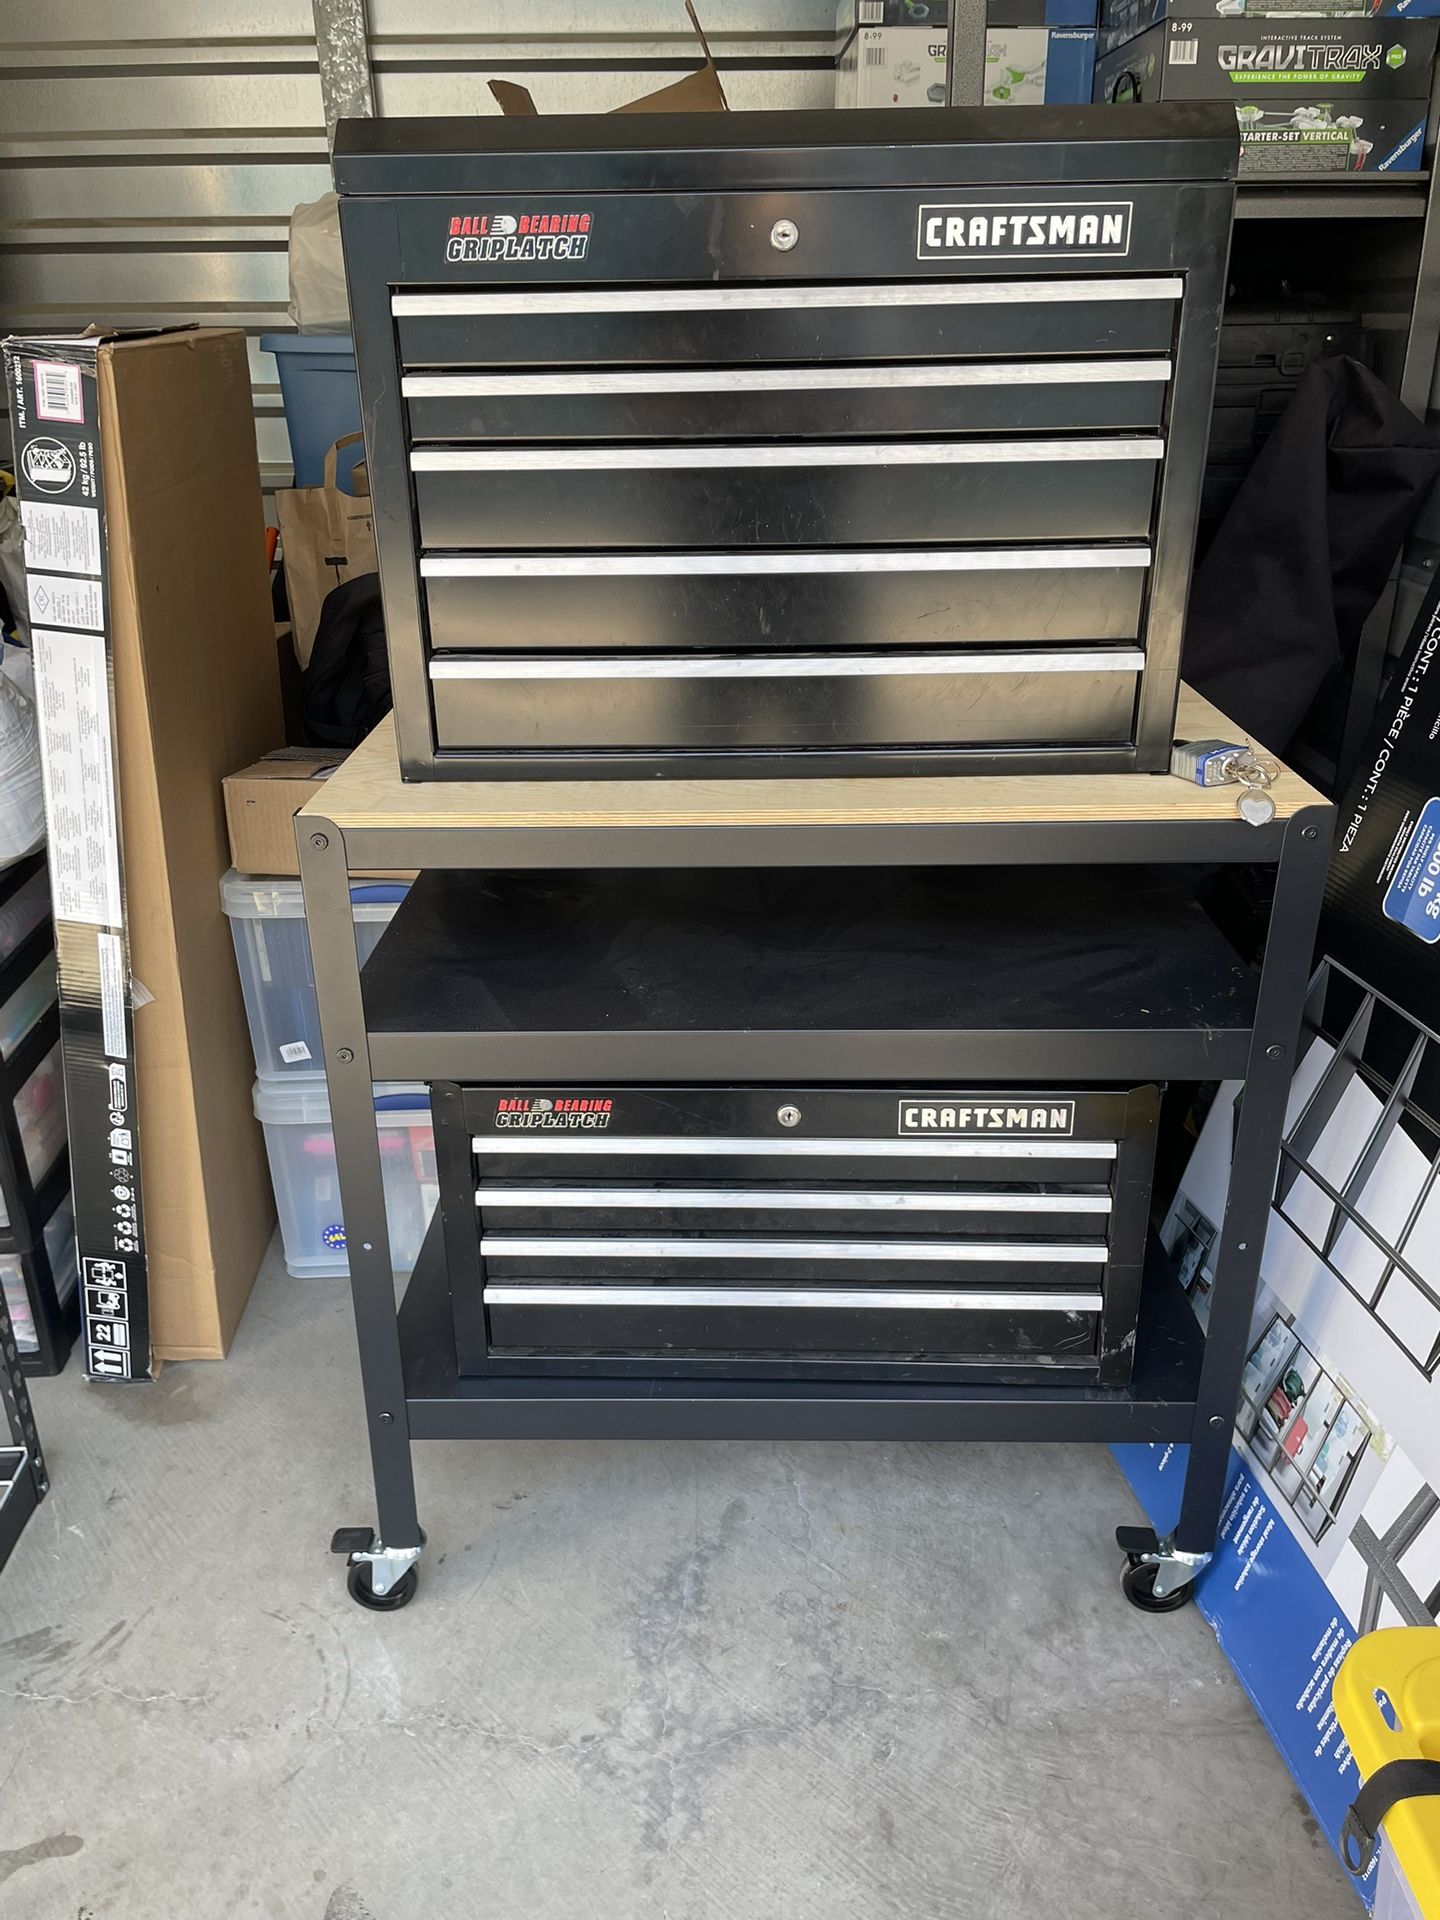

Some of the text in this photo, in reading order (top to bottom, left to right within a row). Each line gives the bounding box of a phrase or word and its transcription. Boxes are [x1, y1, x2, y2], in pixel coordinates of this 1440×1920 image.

[864, 32, 883, 41] 8-99
[1050, 31, 1095, 41] Ravensburger
[1171, 22, 1193, 33] 8-99
[1217, 44, 1383, 70] GRAVITRAX
[1235, 73, 1275, 81] EXPERIENCE
[1302, 131, 1349, 141] VERTICAL
[1378, 127, 1423, 172] Ravensburger
[449, 213, 591, 236] BALL BEARING
[925, 213, 1124, 248] CRAFTSMAN
[446, 234, 589, 262] GRIPLATCH
[79, 442, 86, 450] lb
[82, 474, 90, 485] kg
[82, 486, 89, 496] 42
[1389, 696, 1413, 739] PIÈCE
[1365, 749, 1389, 794] CONT.
[1340, 814, 1362, 851] PIEZA
[1407, 863, 1421, 890] CAPACITY
[1418, 877, 1434, 896] lb
[498, 1098, 614, 1112] BALL BEARING
[495, 1112, 611, 1128] GRIPLATCH
[905, 1107, 1068, 1129] CRAFTSMAN
[96, 1323, 111, 1342] 22
[1235, 1473, 1244, 1491] para
[1221, 1483, 1251, 1539] La solución ideal
[1233, 1496, 1259, 1544] de rangement
[1248, 1505, 1265, 1534] Solution
[1235, 1519, 1274, 1590] Ideal storage solution
[1330, 1617, 1337, 1628] de
[1333, 1639, 1352, 1670] Repisas
[1296, 1628, 1344, 1710] de madera con acabado
[1328, 1667, 1335, 1677] de
[1314, 1745, 1322, 1756] de
